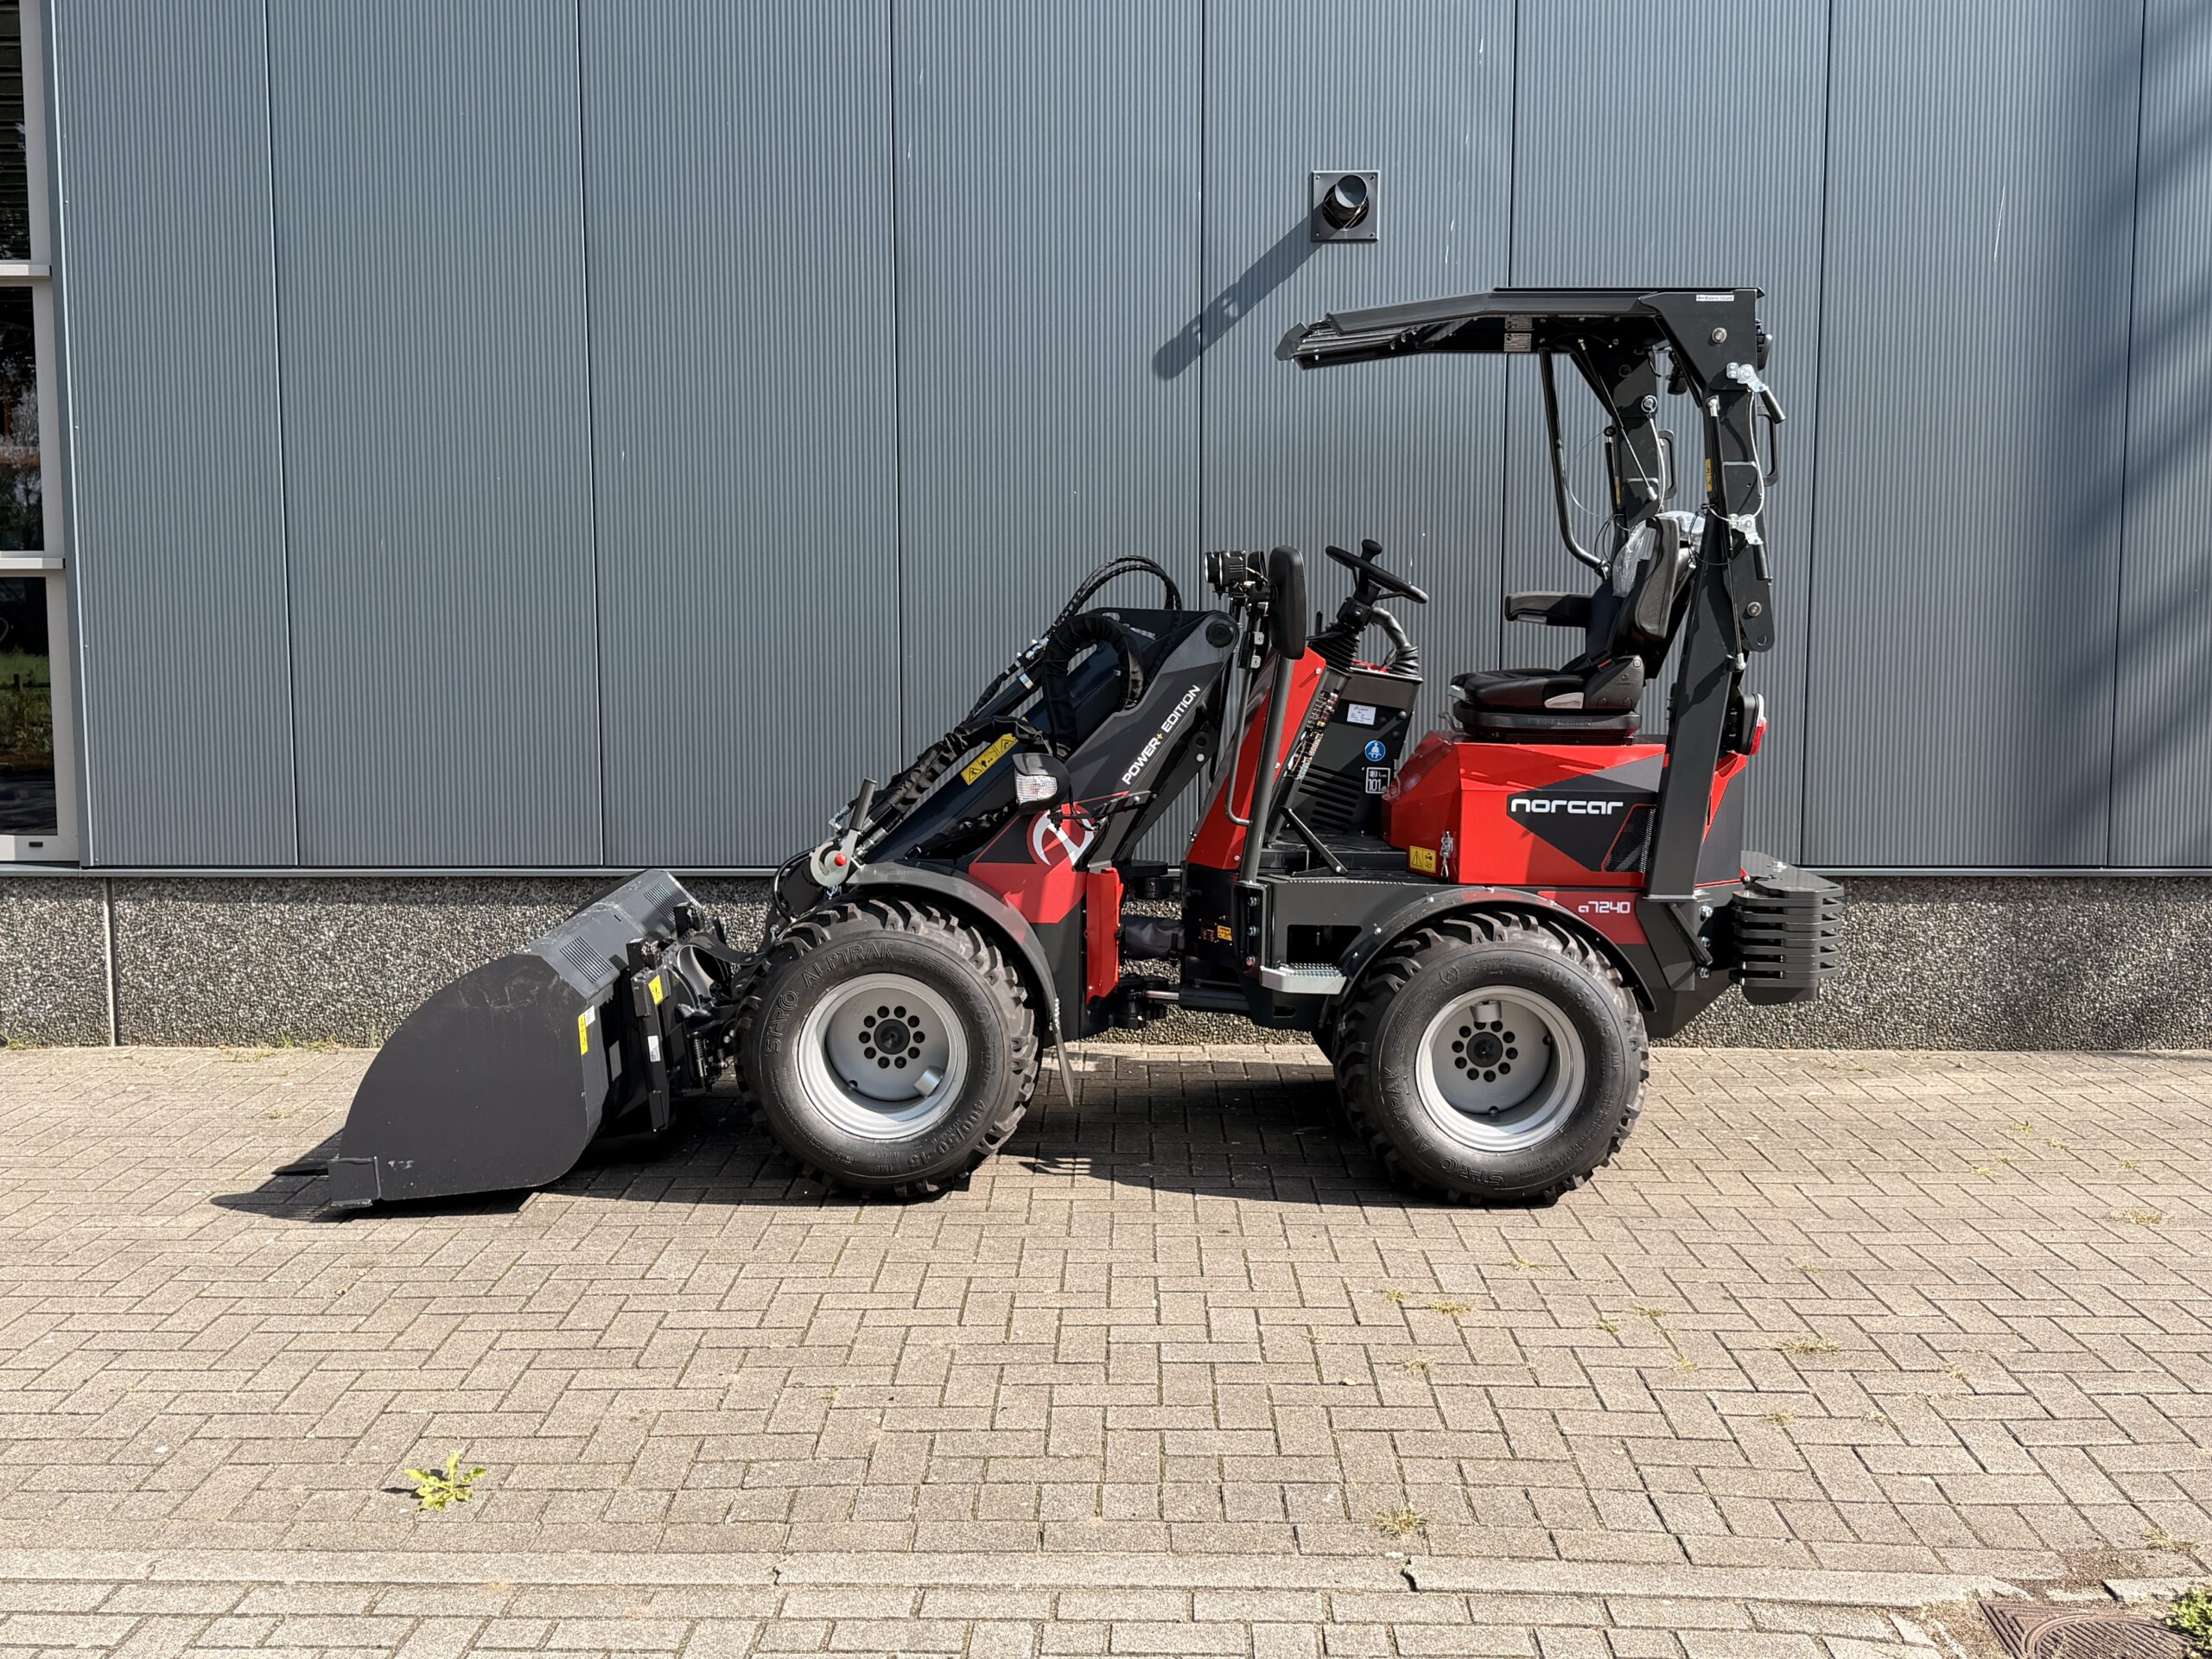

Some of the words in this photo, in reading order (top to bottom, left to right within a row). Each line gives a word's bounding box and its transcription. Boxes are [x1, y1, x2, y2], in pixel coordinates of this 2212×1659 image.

[1160, 684, 1201, 733] EDITION
[1368, 779, 1382, 791] 101
[1511, 798, 1624, 815] norcar
[1578, 900, 1630, 914] a7240
